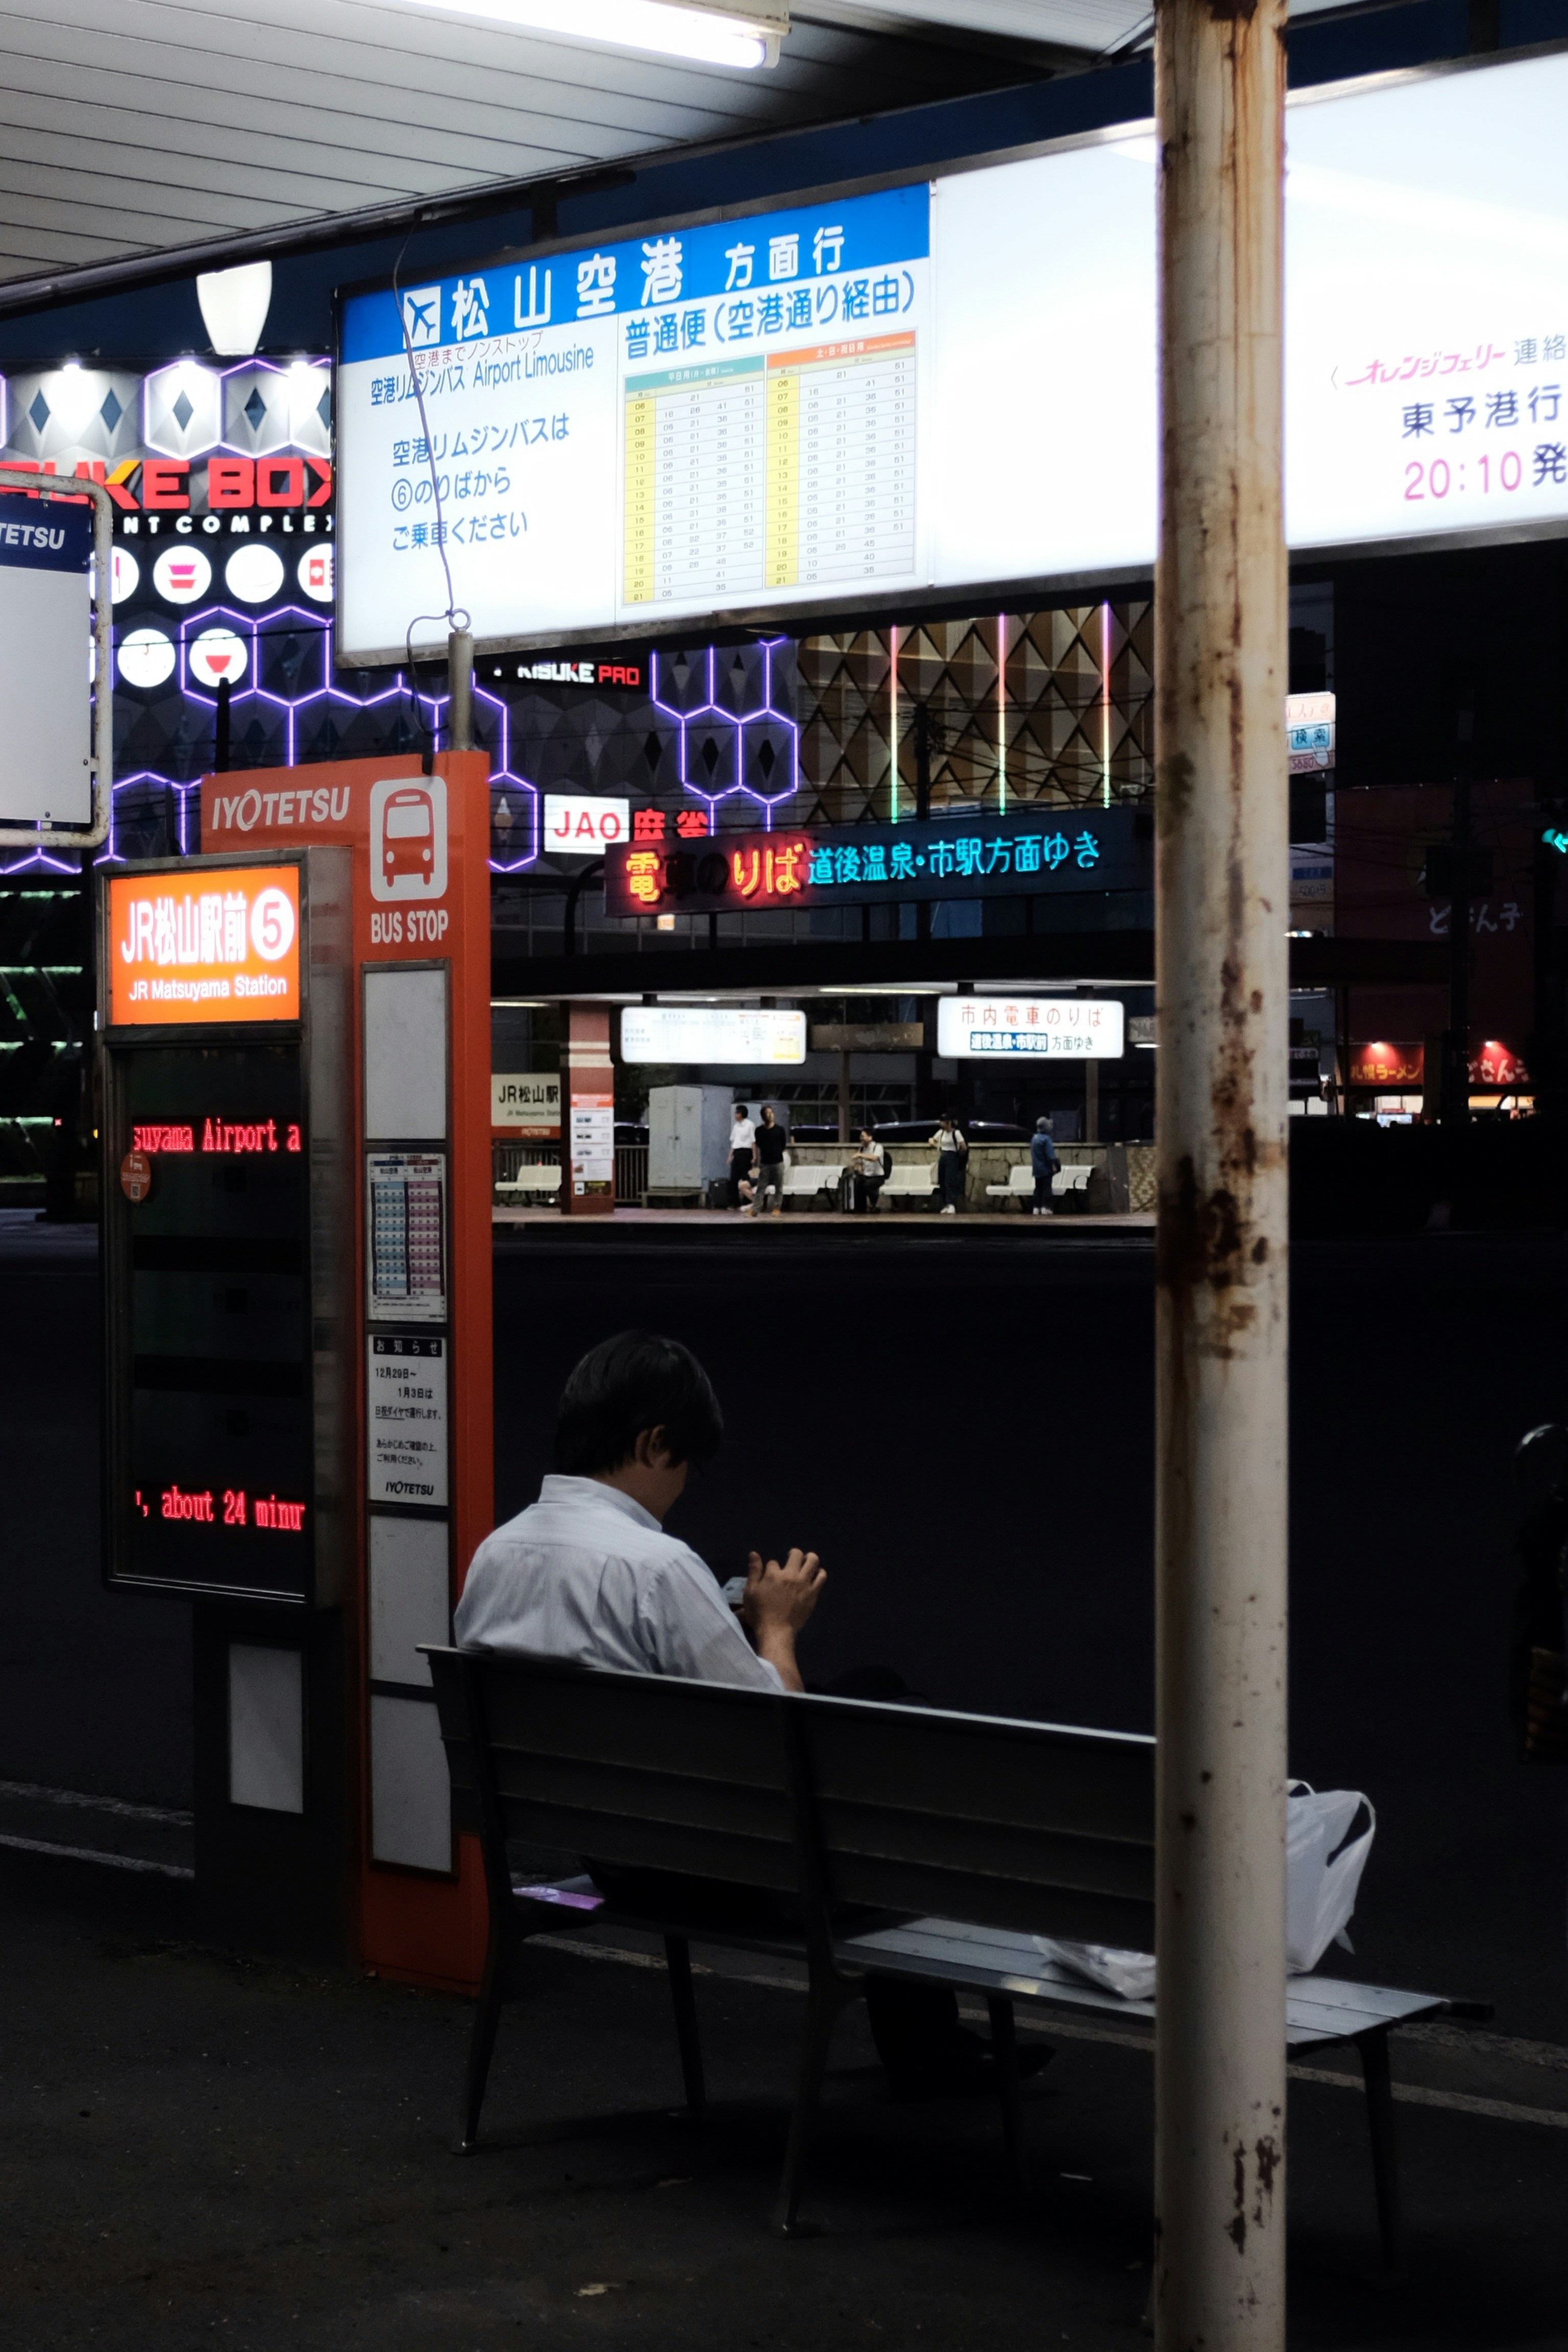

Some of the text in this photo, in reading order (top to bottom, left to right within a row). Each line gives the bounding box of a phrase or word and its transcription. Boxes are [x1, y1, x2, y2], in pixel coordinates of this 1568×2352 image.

[414, 331, 544, 370] 空港までノンストップ
[371, 344, 594, 406] 空港リムジンバス Airport Limousine
[1402, 384, 1562, 438] 東予港行
[393, 413, 570, 467] 空港リムジンバスは
[393, 512, 528, 551] ご乗車ください
[599, 666, 639, 685] PRO
[1296, 728, 1326, 745] 検索
[212, 787, 350, 831] IYOTETSU
[554, 811, 621, 840] JAO
[121, 891, 248, 965] JR松山駅前
[371, 910, 449, 944] BUS STOP
[1428, 901, 1524, 935] どん子
[130, 975, 286, 1002] JR Matsuyama Station
[962, 1004, 1104, 1027] 市内電車のりば
[1052, 1036, 1093, 1050] 方面ゆき
[499, 1085, 559, 1104] JR松山駅
[202, 1118, 278, 1154] Airport
[377, 1338, 437, 1355] お知らせ
[162, 1485, 214, 1522] about
[223, 1489, 246, 1526] 24
[385, 1481, 434, 1496] IYOTETSU
